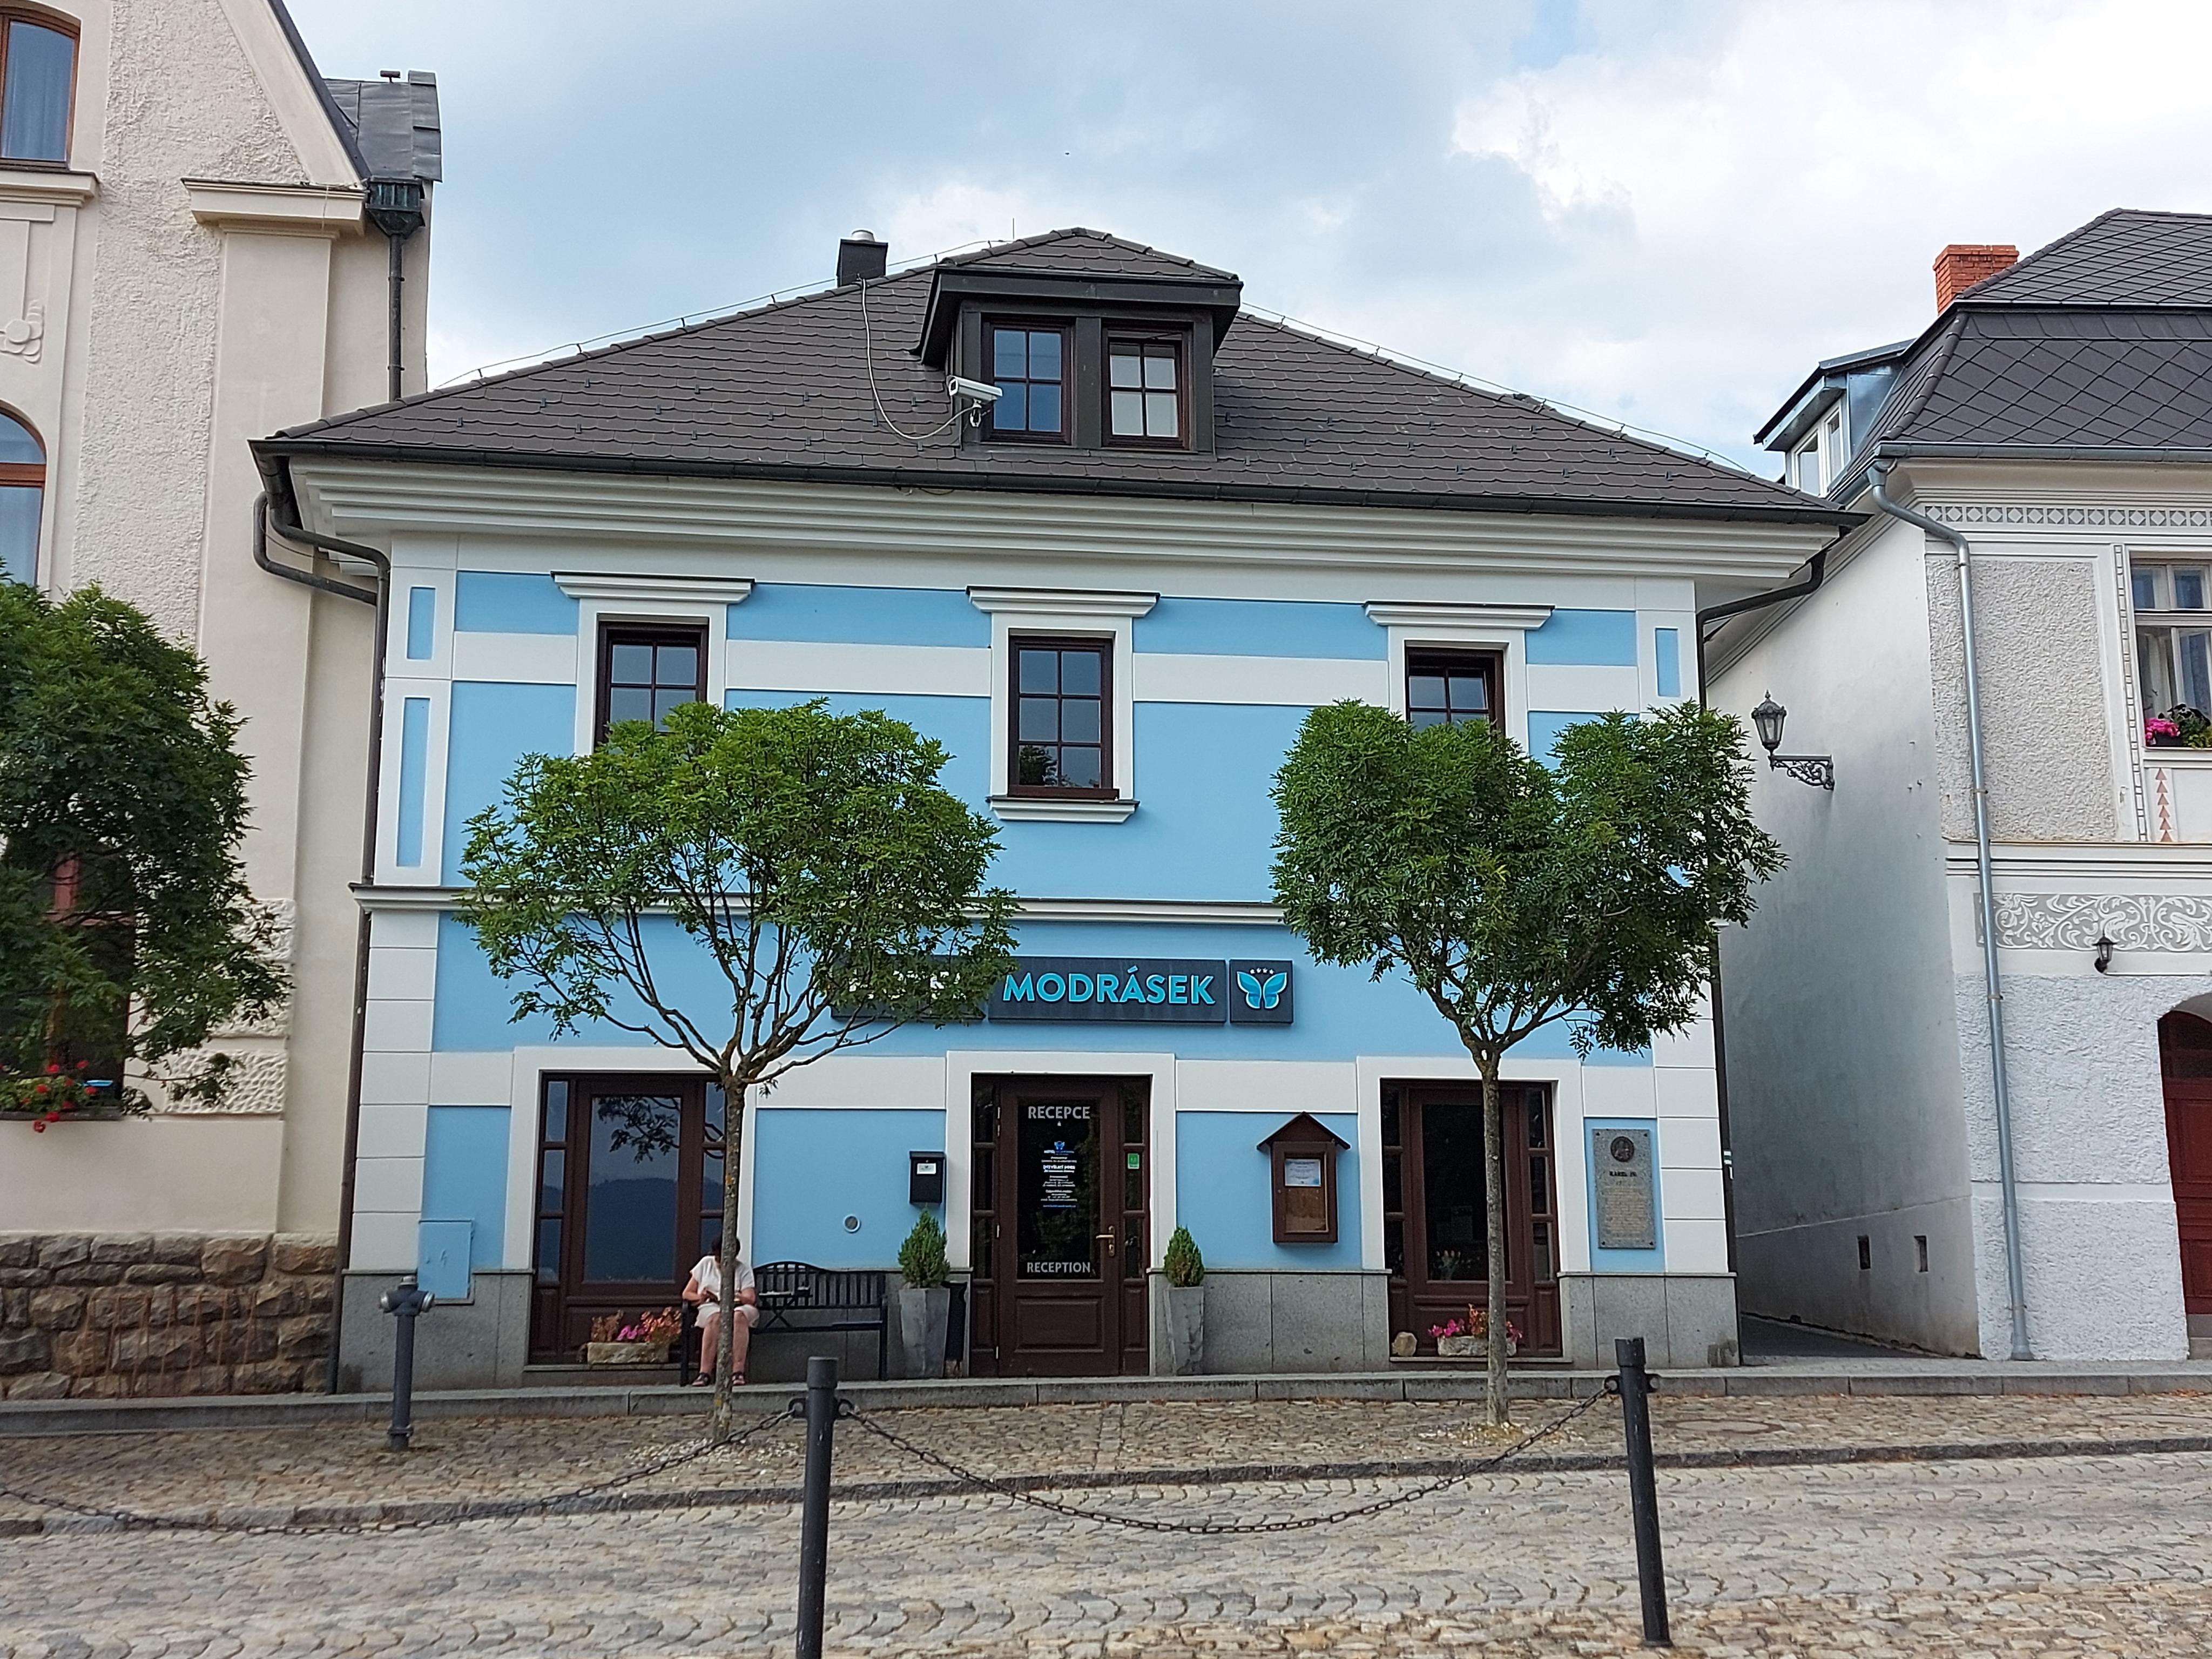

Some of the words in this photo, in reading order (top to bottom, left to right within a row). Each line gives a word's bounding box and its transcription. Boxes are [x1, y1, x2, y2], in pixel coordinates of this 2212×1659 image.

[1002, 965, 1216, 1004] MODRÁSEK
[1028, 1105, 1090, 1120] RECEPCE
[1027, 1262, 1090, 1273] RECEPTION
